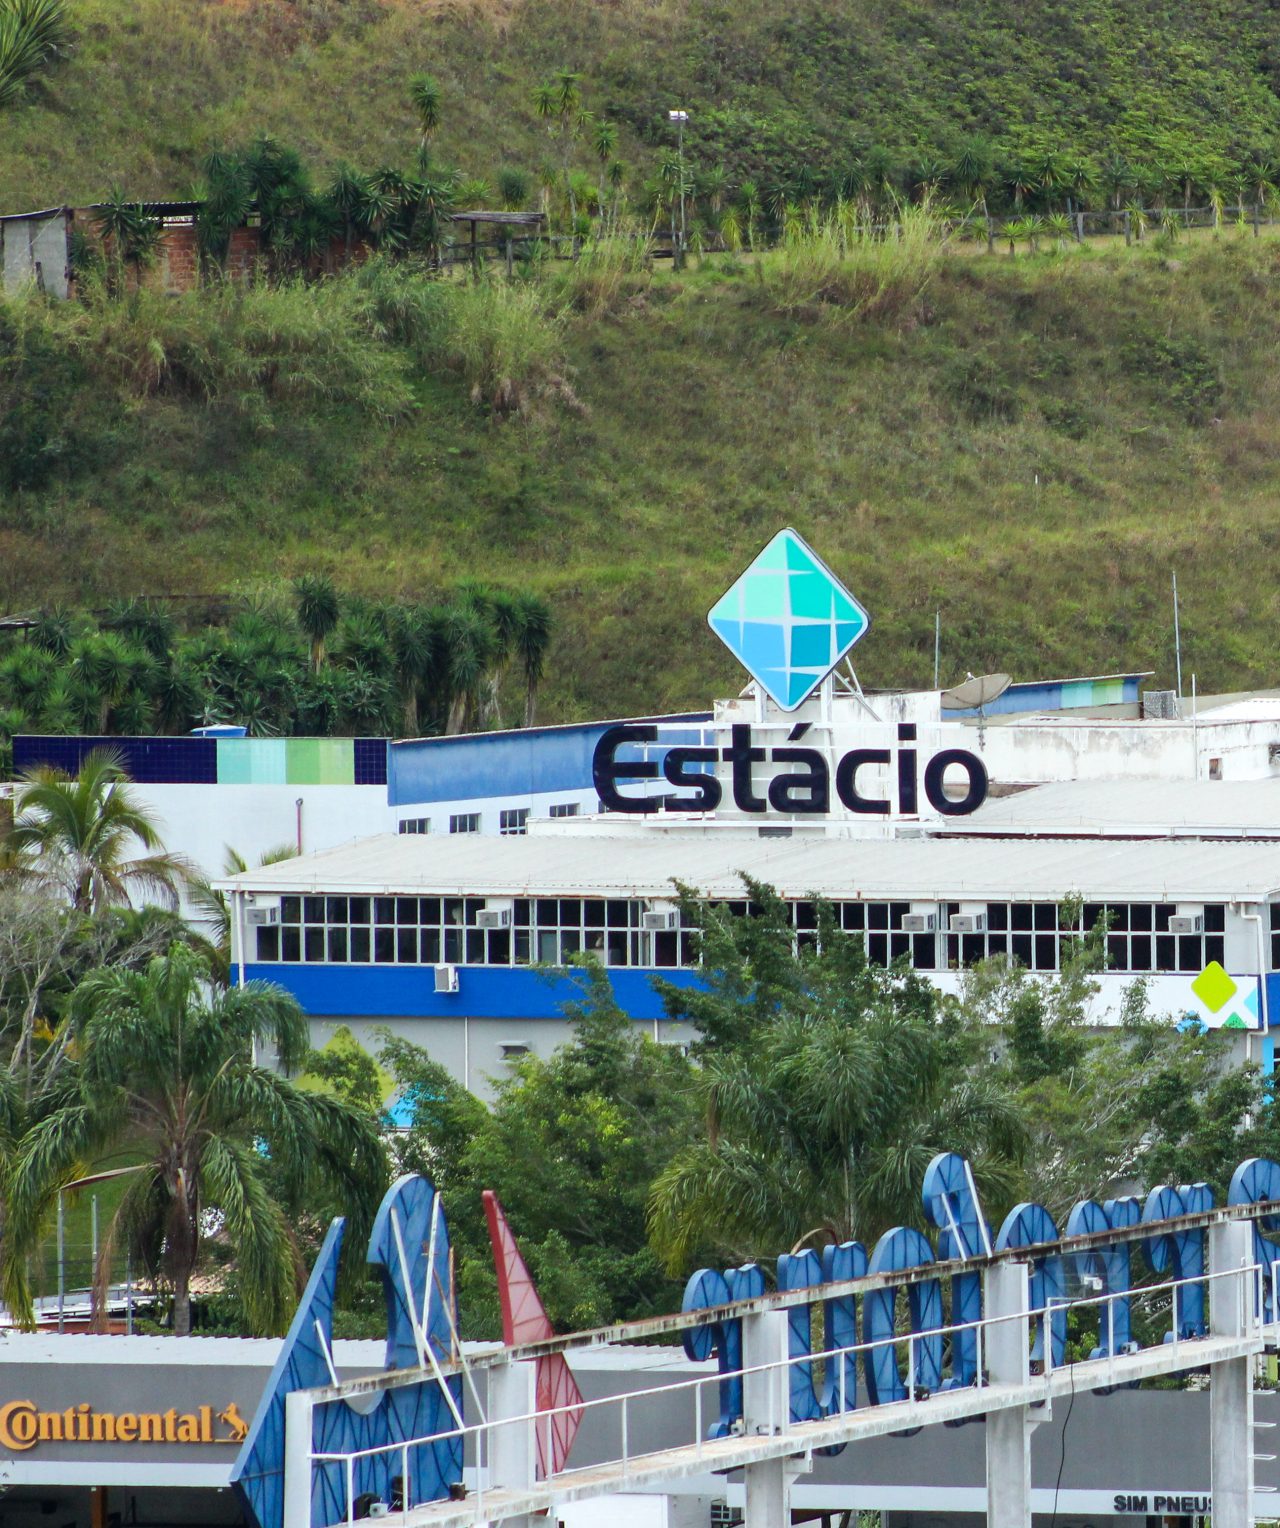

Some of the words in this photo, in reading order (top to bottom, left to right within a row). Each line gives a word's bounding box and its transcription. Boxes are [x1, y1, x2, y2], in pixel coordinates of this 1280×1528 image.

[593, 722, 989, 816] Estácio
[0, 1399, 214, 1451] Continental
[1113, 1495, 1148, 1512] SIM
[1153, 1495, 1212, 1513] PNEU
